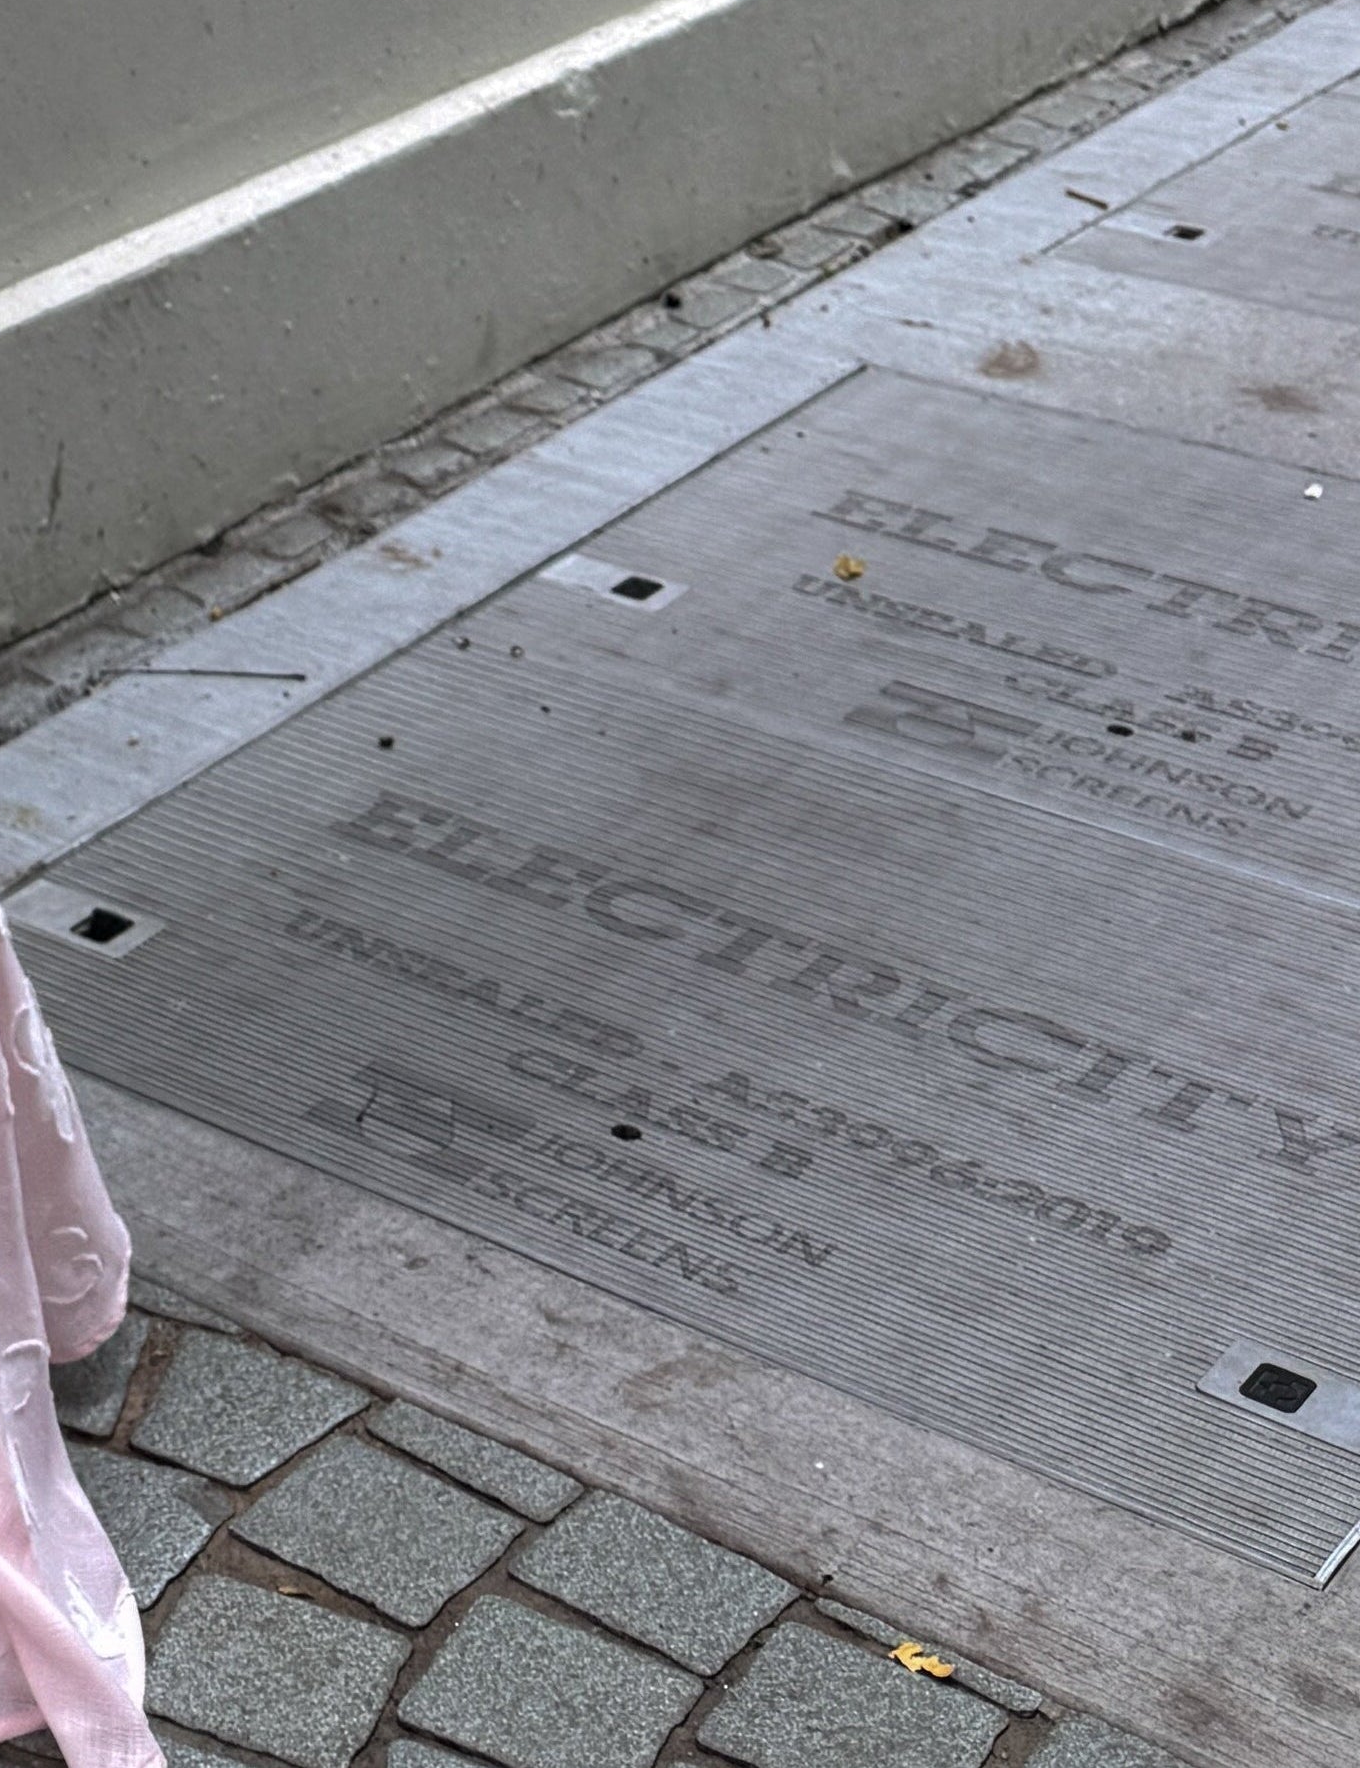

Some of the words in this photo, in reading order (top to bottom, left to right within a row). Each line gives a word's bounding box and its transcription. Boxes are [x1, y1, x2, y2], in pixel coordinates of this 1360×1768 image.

[791, 573, 1118, 678] UNSEALED
[1003, 673, 1222, 743] CLASS
[1226, 734, 1281, 763] B
[1044, 729, 1313, 820] JOHNSON
[1002, 753, 1248, 837] SCREENS
[283, 908, 644, 1062] UNSEALED
[326, 787, 1360, 1177] ELECTRICITY
[503, 1048, 752, 1154] CLASS
[756, 1139, 818, 1184] B
[468, 1169, 740, 1297] SCREENS
[526, 1132, 839, 1267] JOHNSON
